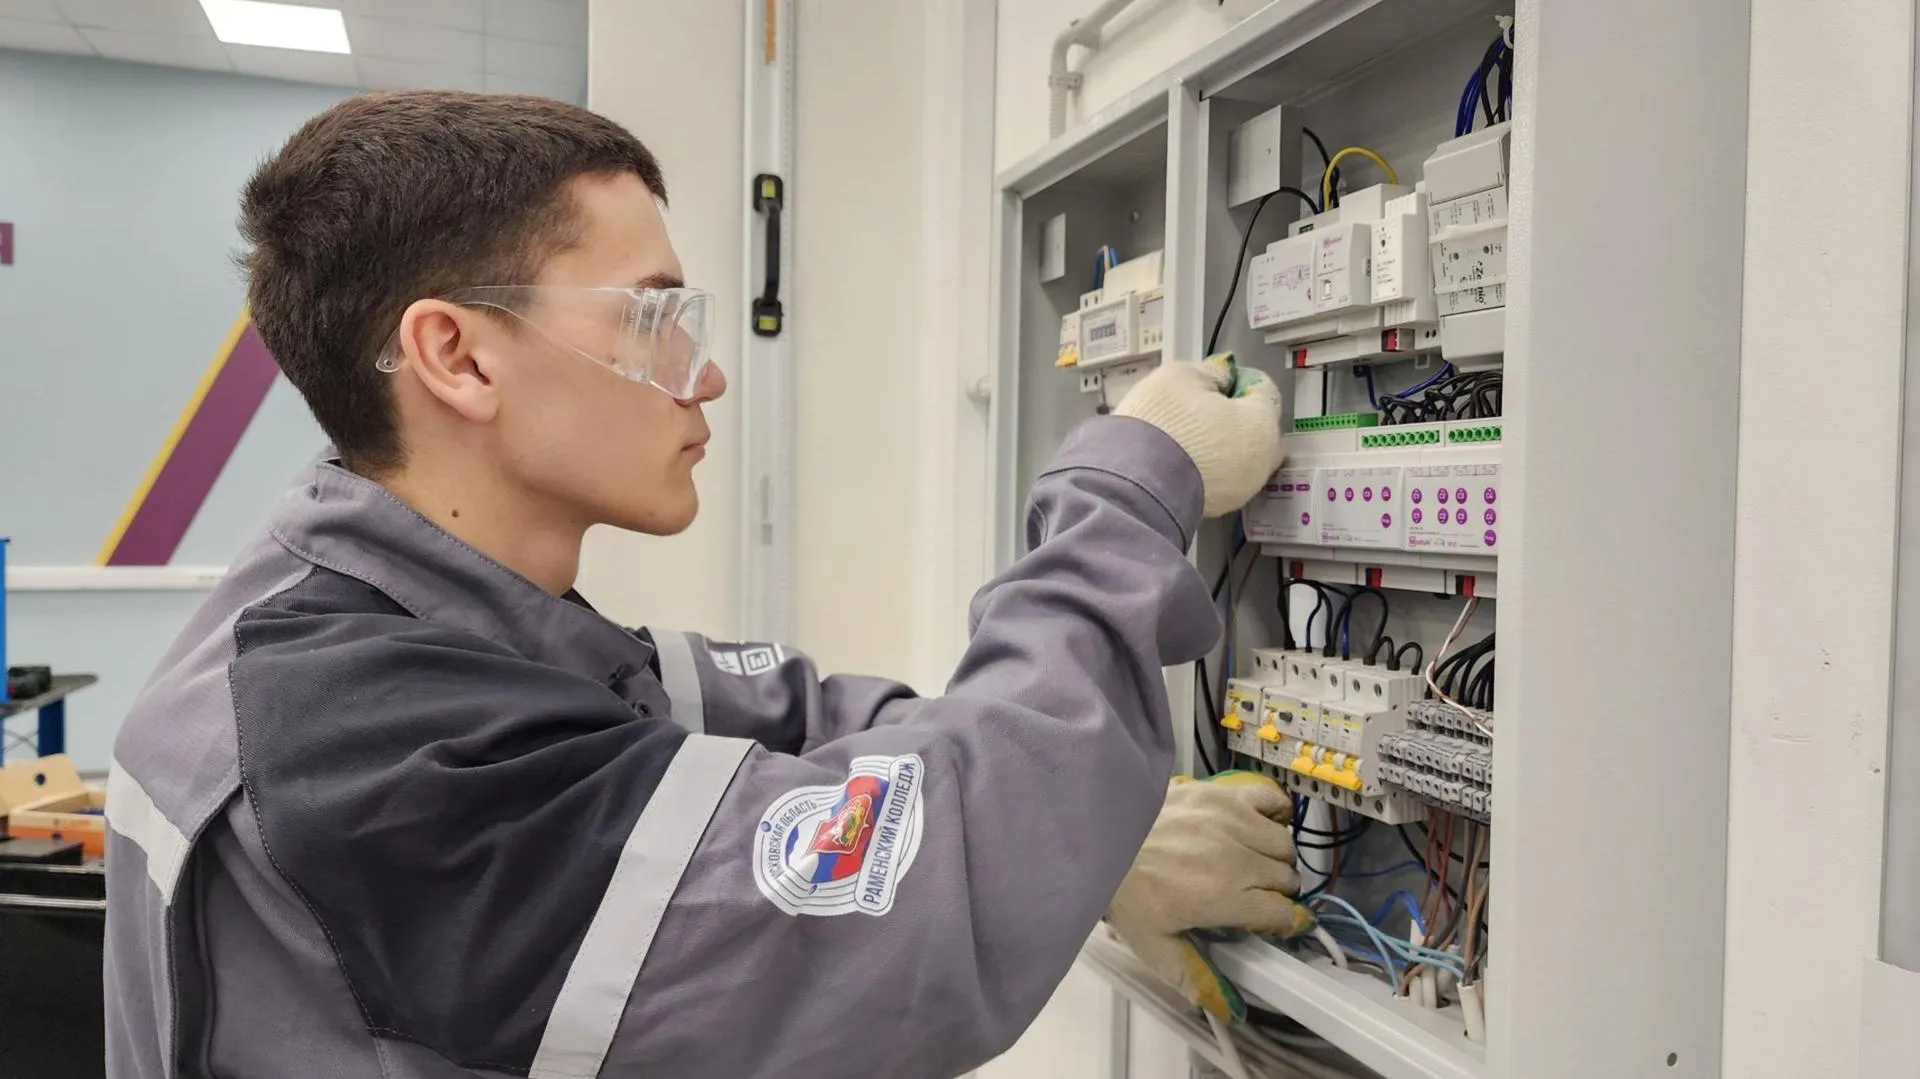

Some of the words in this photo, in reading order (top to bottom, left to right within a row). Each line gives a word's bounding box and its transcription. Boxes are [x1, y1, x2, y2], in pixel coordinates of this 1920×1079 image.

[768, 823, 786, 878] СКОВСКАЯ
[779, 800, 818, 828] ОБЛАСТЬ
[863, 825, 898, 906] РАМЕНСКИЙ
[885, 762, 916, 826] КОЛЛЕДЖ
